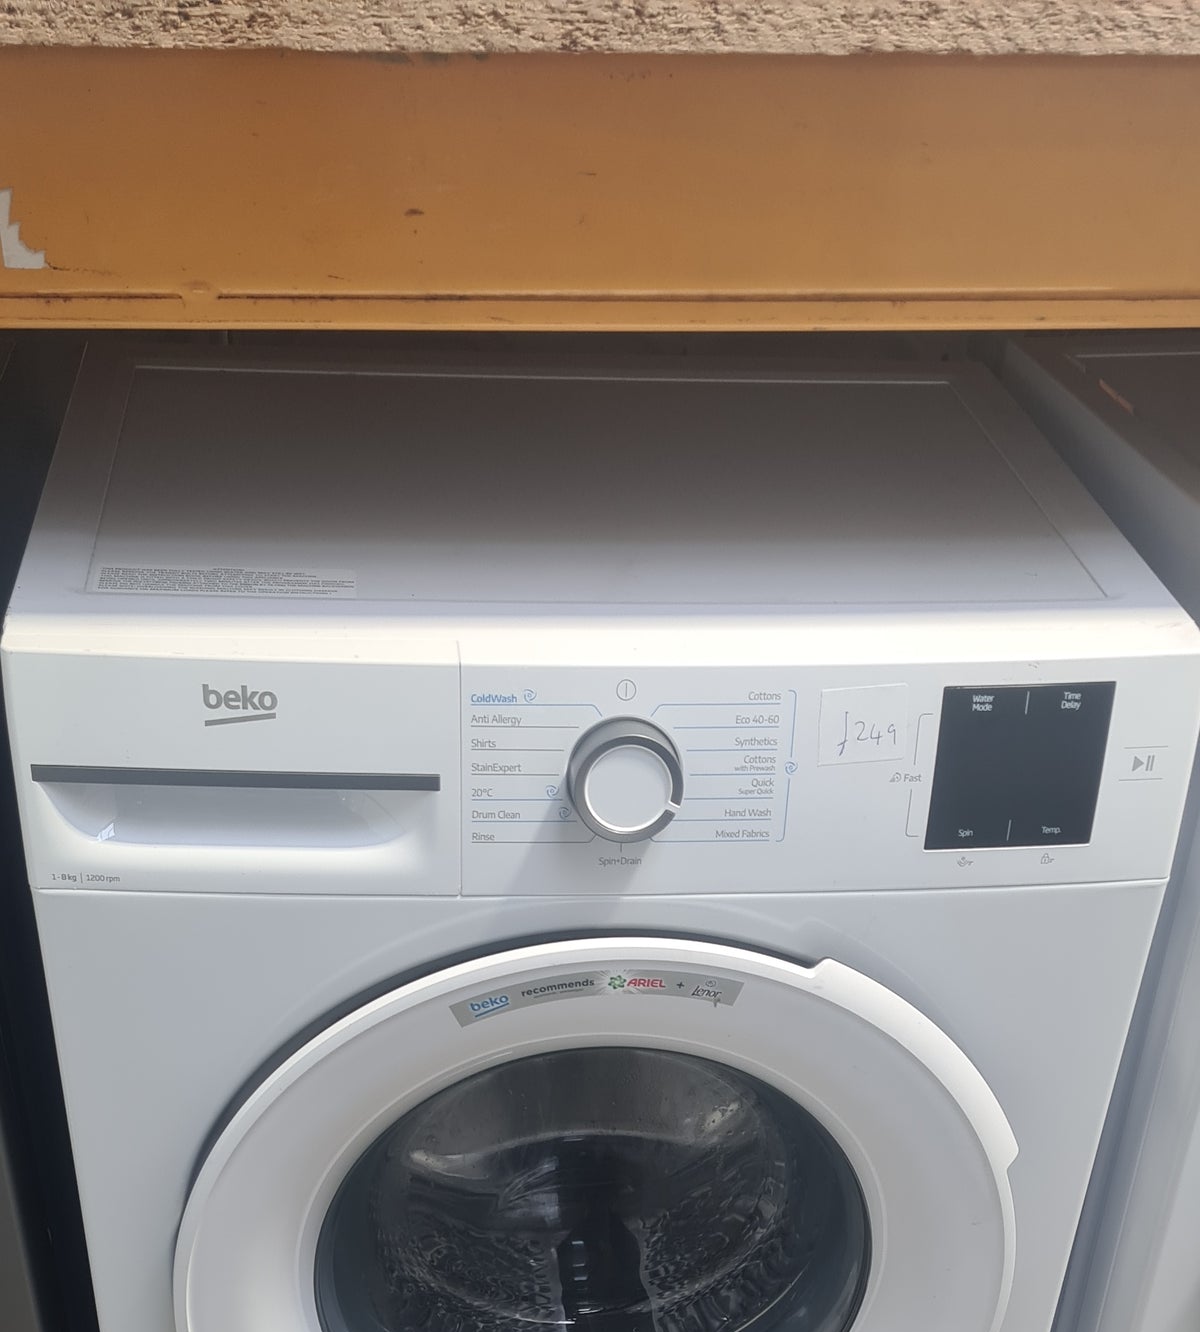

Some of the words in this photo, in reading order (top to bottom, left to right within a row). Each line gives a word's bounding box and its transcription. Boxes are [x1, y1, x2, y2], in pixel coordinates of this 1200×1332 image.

[202, 684, 278, 711] beko
[471, 694, 517, 704] ColdWash
[748, 691, 781, 701] Cottons
[972, 694, 994, 704] Water
[1063, 692, 1081, 700] Time
[972, 702, 992, 712] Mode
[1060, 700, 1081, 711] Delay
[471, 715, 490, 724] Anti
[492, 715, 522, 727] Allergy
[735, 715, 750, 724] Eco
[752, 715, 779, 724] 40-60
[471, 739, 496, 748] Shirts
[734, 737, 778, 748] Synthetics
[743, 755, 776, 765] Cottons
[471, 763, 522, 774] StainExpert
[751, 778, 775, 788] Quick
[903, 773, 922, 783] Fast
[738, 788, 754, 796] Super
[756, 787, 774, 796] Quick
[471, 810, 495, 819] Drum
[497, 810, 521, 819] Clean
[724, 808, 746, 817] Hand
[748, 808, 772, 817] Wash
[471, 832, 495, 841] Rinse
[715, 830, 740, 839] Mixed
[741, 830, 770, 839] Fabrics
[958, 829, 973, 838] Spin
[470, 994, 509, 1013] beko
[520, 978, 595, 998] recommends
[627, 978, 666, 988] ARIEL
